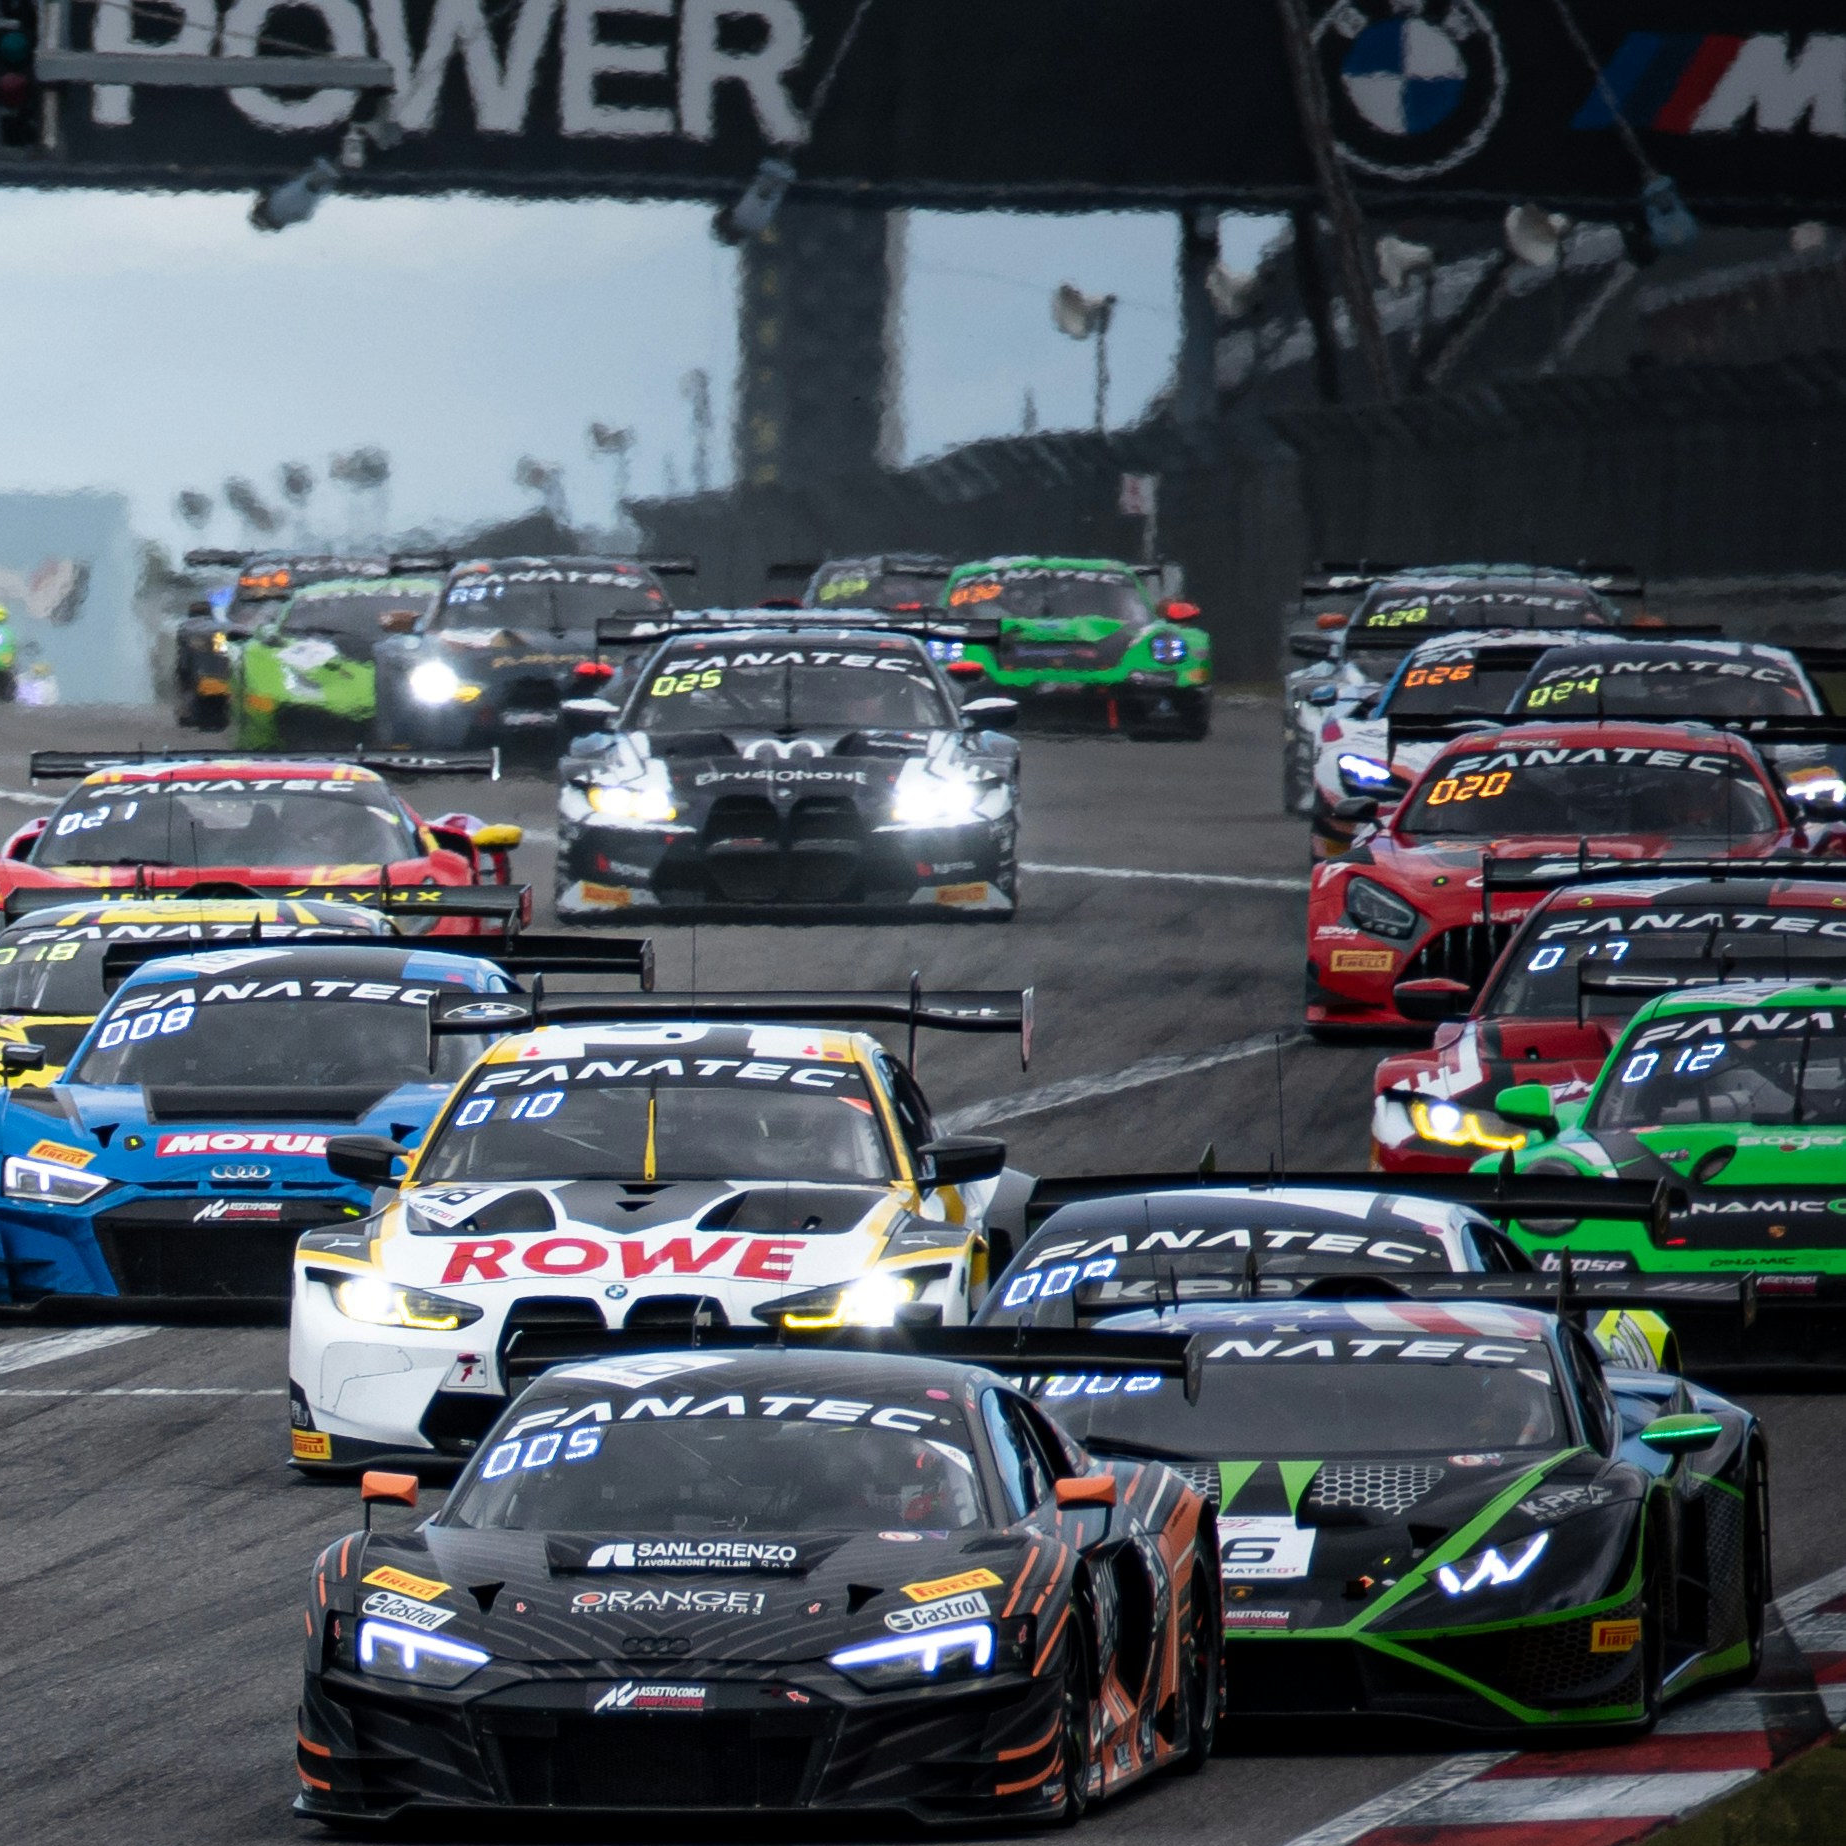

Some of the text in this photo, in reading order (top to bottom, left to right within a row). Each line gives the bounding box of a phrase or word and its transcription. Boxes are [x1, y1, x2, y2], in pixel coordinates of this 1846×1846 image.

[91, 0, 811, 143] POWER
[663, 652, 912, 674] FANATEC
[1541, 660, 1789, 684] FANATEC
[651, 669, 723, 698] 025
[1528, 677, 1600, 709] 024
[1446, 747, 1729, 780] FANATEC
[89, 780, 355, 798] FANATEC
[1427, 771, 1512, 806] 020
[111, 980, 437, 1020] FANATEC
[98, 1006, 196, 1050] 008
[1634, 1011, 1846, 1051] FANA
[475, 1058, 851, 1092] FANATEC
[1622, 1044, 1725, 1085] 012
[455, 1089, 564, 1128] 010
[35, 1144, 89, 1164] PIRELLI
[162, 1133, 328, 1155] MOTUL
[440, 1236, 807, 1285] ROWE
[1026, 1229, 1428, 1271] FANATEC
[1206, 1339, 1530, 1363] NATEC
[505, 1396, 936, 1438] FANATEC
[483, 1426, 602, 1480] 005
[636, 1542, 797, 1562] SANLORENZO
[638, 1558, 751, 1568] LAVORAZIONE PELLAMI
[373, 1570, 440, 1597] PIRELLI
[912, 1572, 990, 1598] PIRELLI
[379, 1599, 446, 1627] Castrol
[571, 1605, 761, 1616] ELECTRIC MOTORS
[572, 1590, 767, 1609] ORANGE1
[911, 1596, 986, 1626] Castrol
[638, 1686, 706, 1698] ASSETTO CORSA
